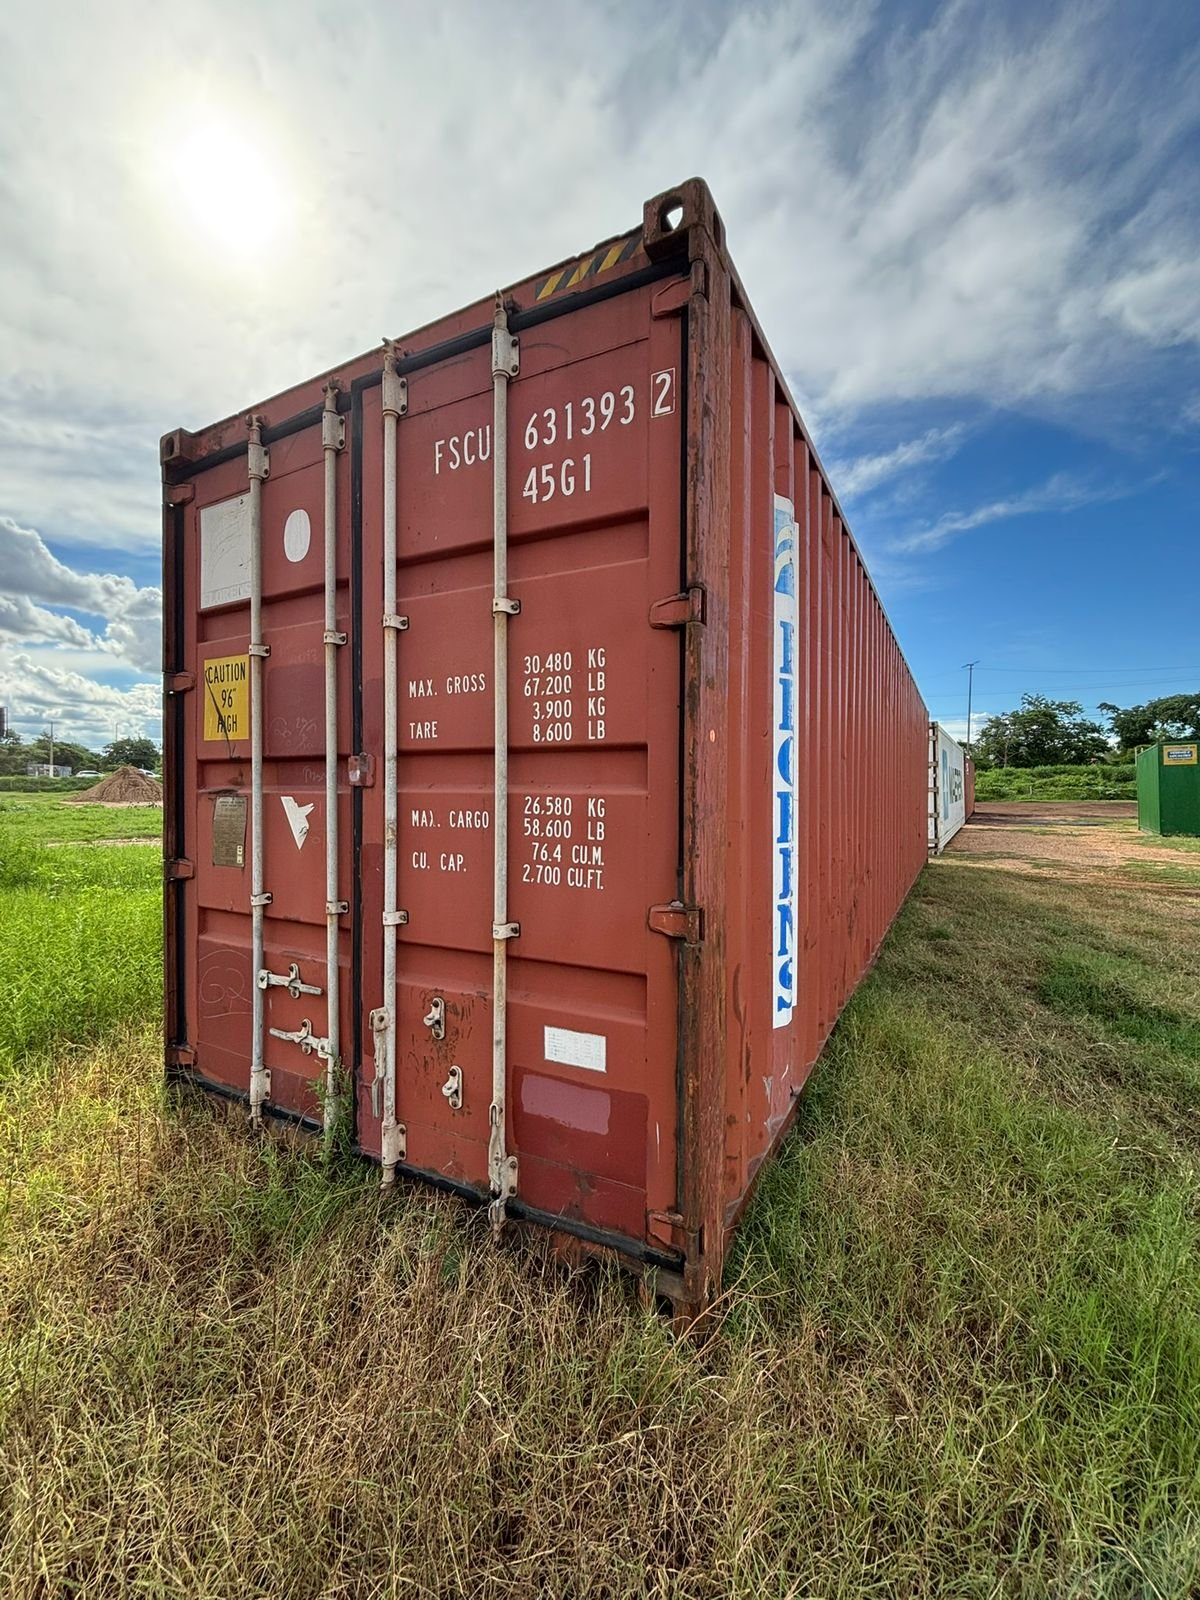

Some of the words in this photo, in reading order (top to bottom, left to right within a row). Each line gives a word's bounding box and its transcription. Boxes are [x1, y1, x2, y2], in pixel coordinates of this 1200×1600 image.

[435, 425, 490, 474] FSCU
[524, 385, 635, 450] 631393
[653, 372, 673, 415] 2
[522, 453, 591, 504] 45G1
[207, 662, 246, 684] CAUTION
[524, 651, 571, 675] 30,480
[588, 648, 605, 668] KG
[409, 679, 437, 698] MAX.
[446, 673, 486, 694] GROSS
[524, 675, 571, 697] 67,200
[588, 672, 605, 692] LB
[532, 699, 571, 720] 3,900
[588, 697, 605, 716] KG
[409, 721, 438, 739] TARE
[532, 722, 572, 742] 8,600
[588, 720, 605, 740] LB
[524, 796, 572, 816] 26,580
[588, 798, 605, 818] KG
[449, 810, 490, 829] CARGO
[524, 818, 572, 838] 58,600
[587, 821, 605, 841] LB
[412, 852, 430, 869] CU.
[440, 853, 467, 872] CAP.
[531, 842, 562, 863] 76.4
[572, 845, 605, 866] CU.M.
[522, 864, 561, 886] 2,700
[567, 868, 604, 890] CU.FT.
